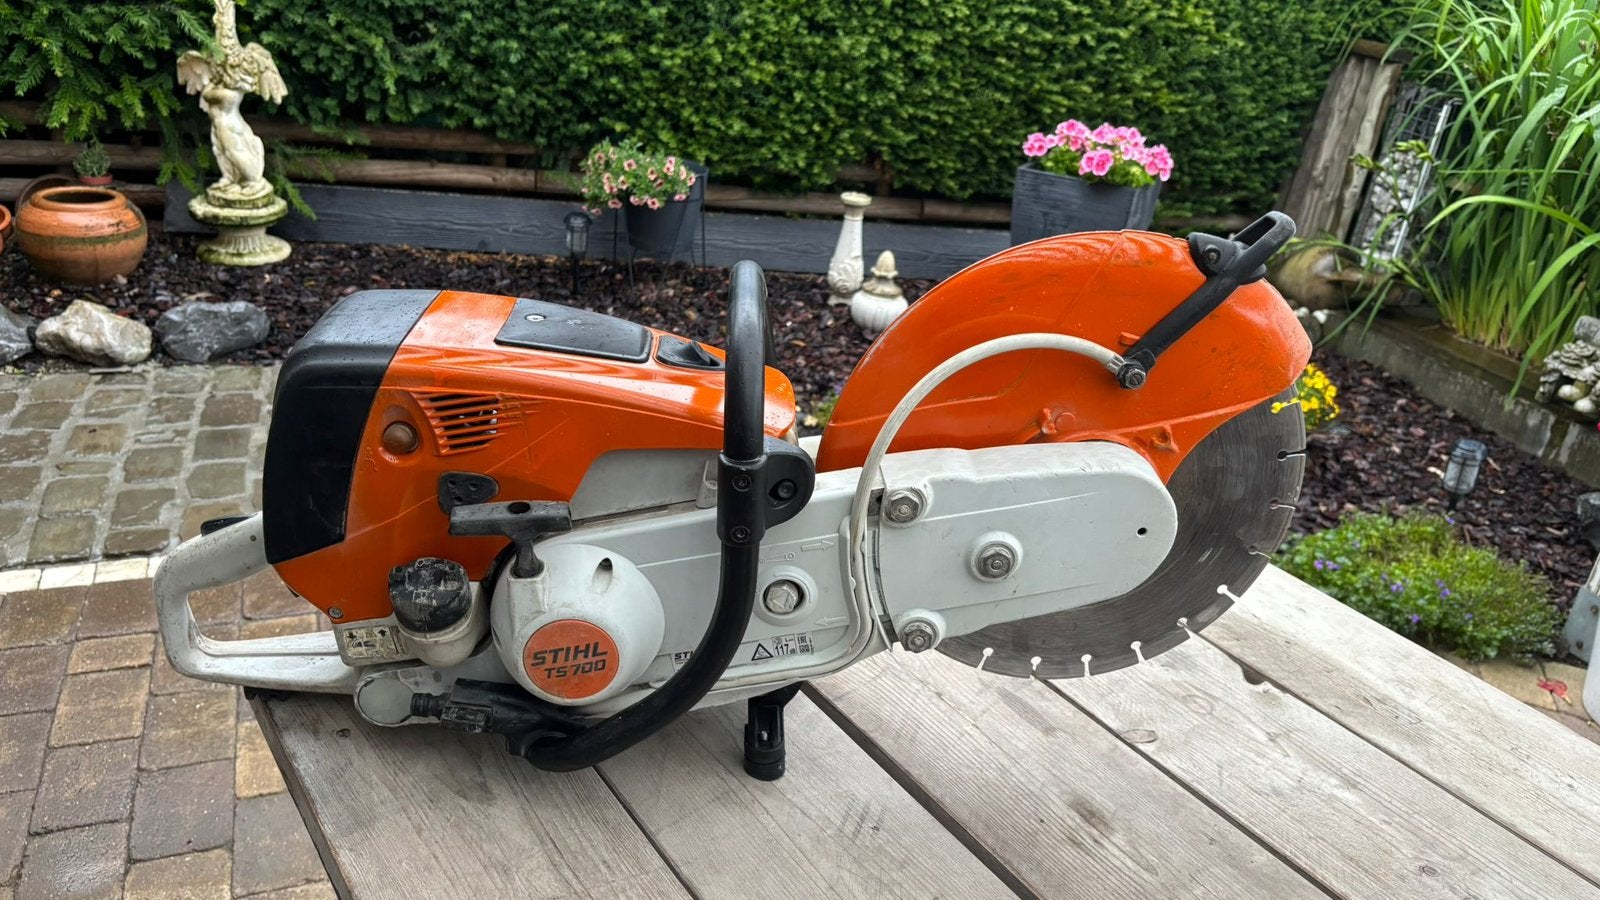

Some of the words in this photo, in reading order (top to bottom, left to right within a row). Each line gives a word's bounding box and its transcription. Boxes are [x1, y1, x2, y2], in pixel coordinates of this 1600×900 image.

[531, 641, 608, 667] STIHL
[674, 650, 694, 660] STI
[775, 643, 789, 656] 117
